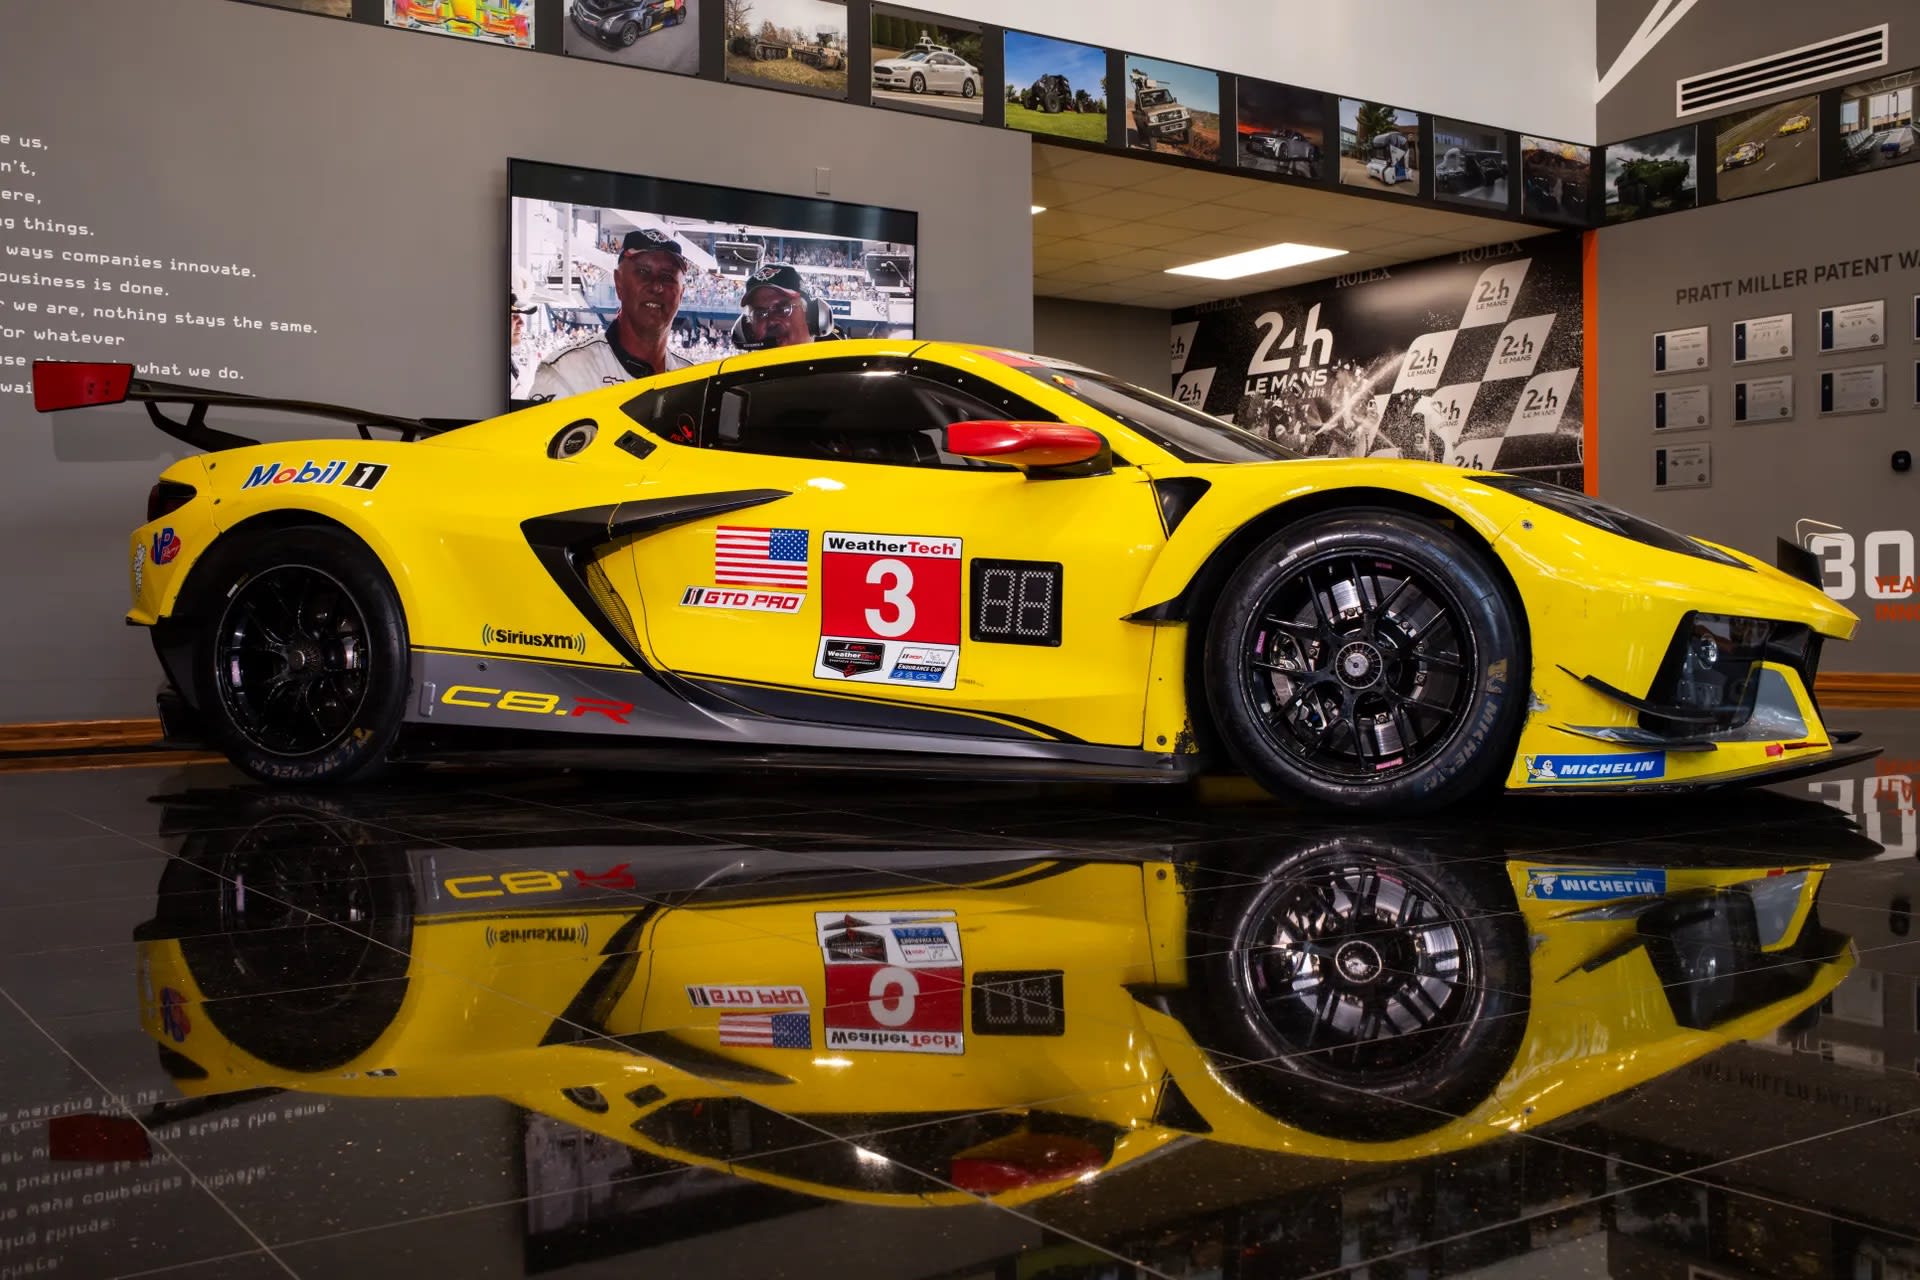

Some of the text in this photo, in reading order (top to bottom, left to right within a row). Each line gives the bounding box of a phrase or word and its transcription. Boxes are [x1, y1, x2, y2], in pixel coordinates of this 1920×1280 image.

[19, 137, 48, 151] us,
[23, 216, 95, 237] things.
[6, 244, 257, 279] ways companies innovate.
[93, 277, 113, 292] is
[119, 280, 170, 297] done.
[1335, 267, 1393, 289] ROLEX
[1676, 248, 1920, 305] PRATT MILLER PATENT W
[1477, 278, 1510, 304] 24h
[13, 300, 38, 313] we
[46, 303, 86, 318] are,
[93, 306, 168, 325] nothing
[174, 311, 227, 329] stays
[232, 315, 264, 330] the
[269, 320, 319, 335] same.
[33, 328, 126, 347] whatever
[1246, 302, 1335, 376] 24h
[1501, 332, 1535, 357] 24h
[136, 361, 182, 377] what
[188, 366, 212, 379] we
[218, 366, 245, 381] do.
[1408, 347, 1438, 371] 24h
[1179, 382, 1203, 403] 24h
[1523, 386, 1558, 412] 24h
[242, 461, 347, 490] Mobil
[1810, 530, 1915, 600] 30
[1874, 574, 1920, 594] YEA
[703, 591, 800, 610] GTD PRO
[864, 558, 916, 638] 3
[441, 684, 635, 725] C8.R
[1560, 760, 1656, 776] MICHELIN
